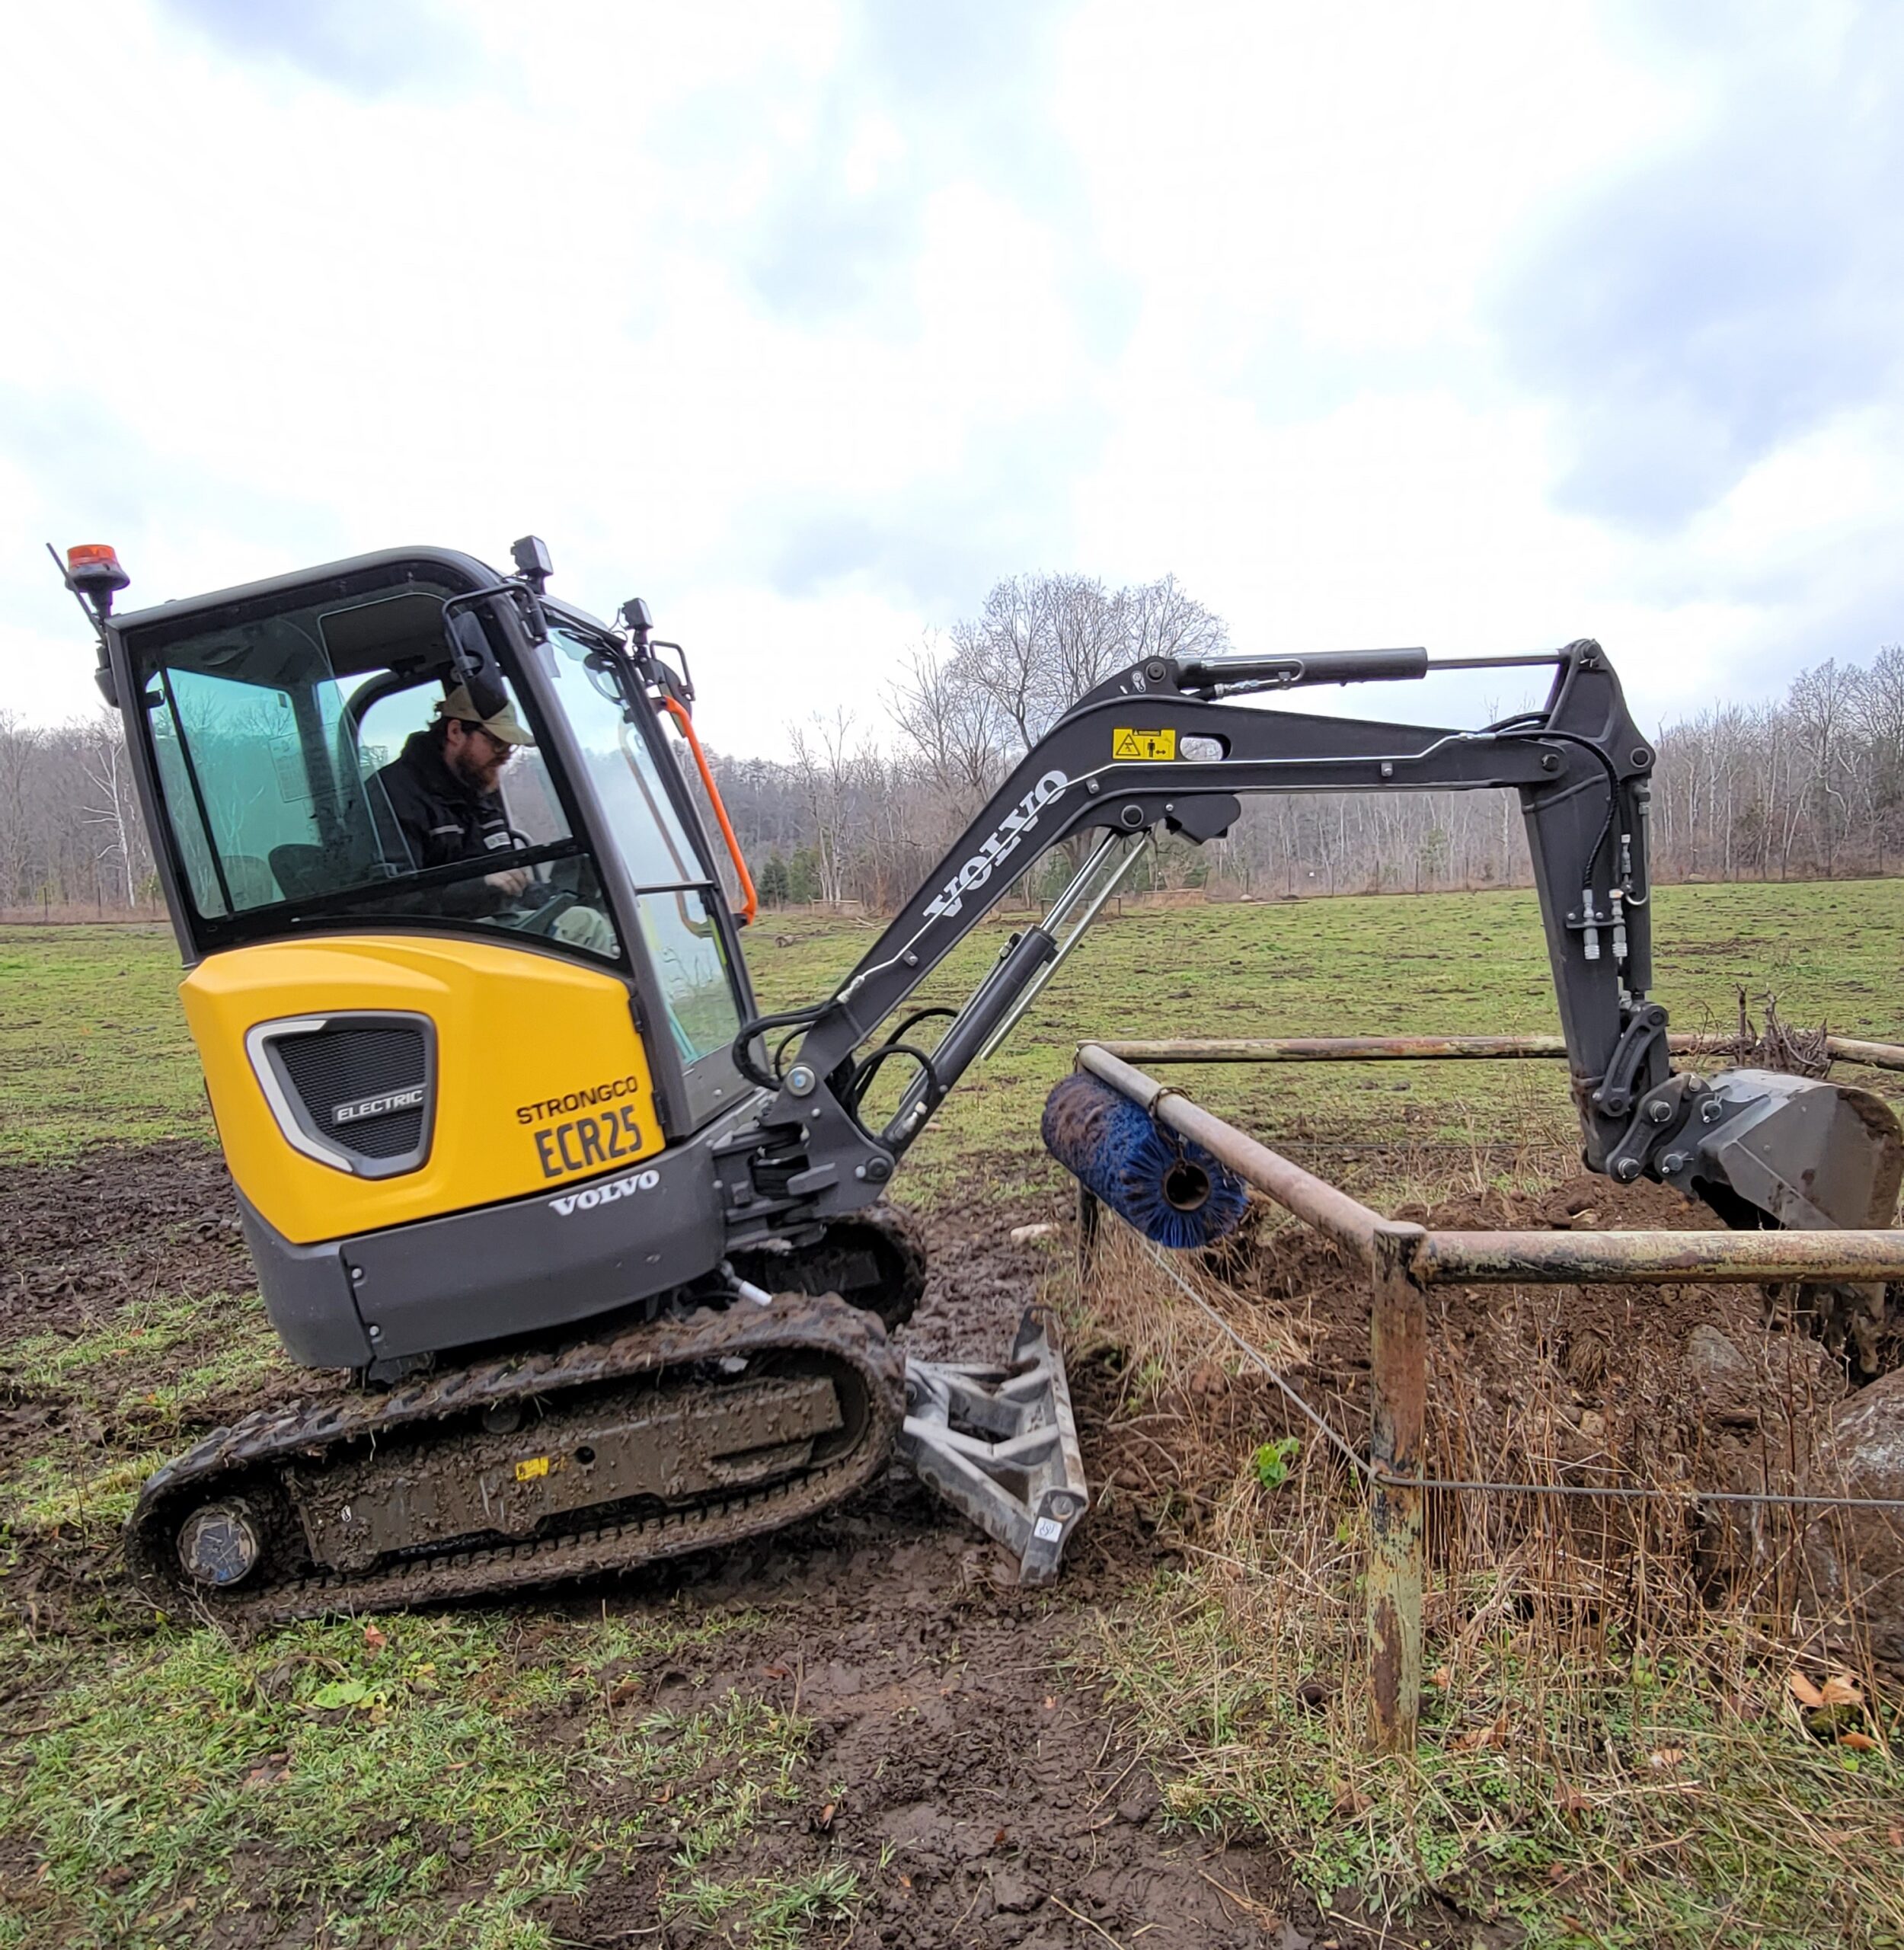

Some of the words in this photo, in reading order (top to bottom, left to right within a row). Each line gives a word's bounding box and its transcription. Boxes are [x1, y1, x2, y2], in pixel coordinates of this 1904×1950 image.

[924, 770, 1067, 917] VOLVO
[337, 1090, 423, 1121] ELECTRIC
[516, 1076, 638, 1124] STRONGCO
[535, 1104, 642, 1178] ECR25
[548, 1170, 660, 1216] VOLVO
